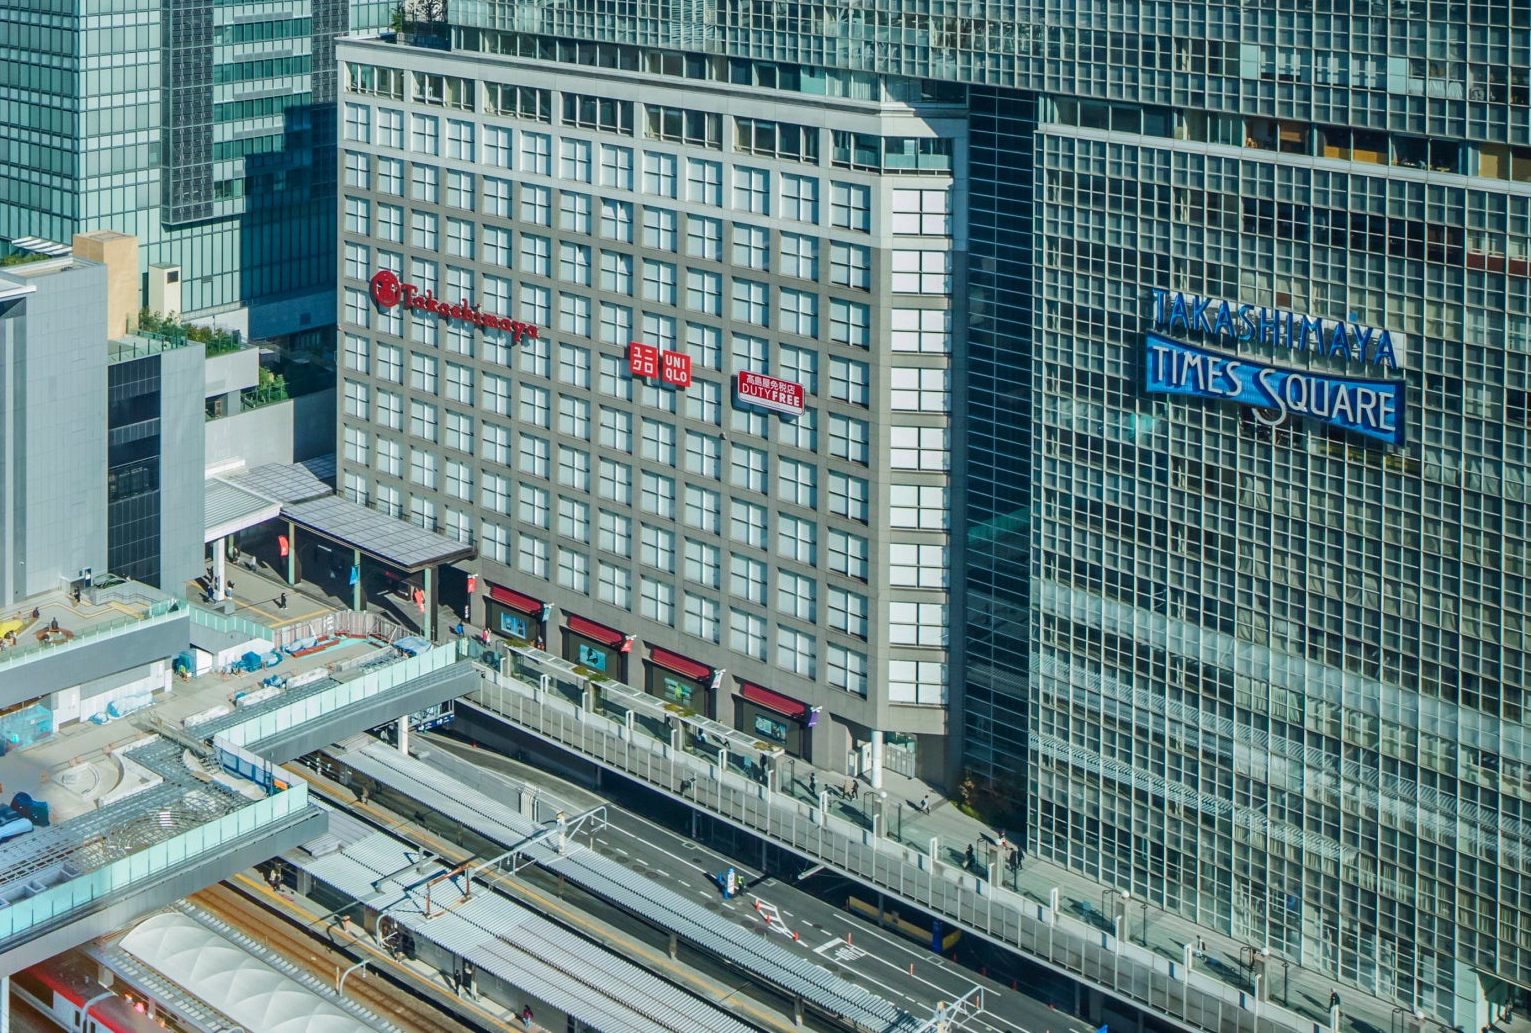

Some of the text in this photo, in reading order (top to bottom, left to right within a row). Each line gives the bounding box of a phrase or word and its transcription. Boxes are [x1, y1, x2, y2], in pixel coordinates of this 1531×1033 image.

[402, 283, 539, 343] Takashimaya
[1152, 288, 1398, 370] TAKASHIMAYA
[633, 346, 654, 361] ユニ
[632, 360, 654, 375] クロ
[665, 356, 686, 369] UNI
[665, 368, 687, 383] QLO
[1153, 345, 1396, 431] TIMES SQUARE
